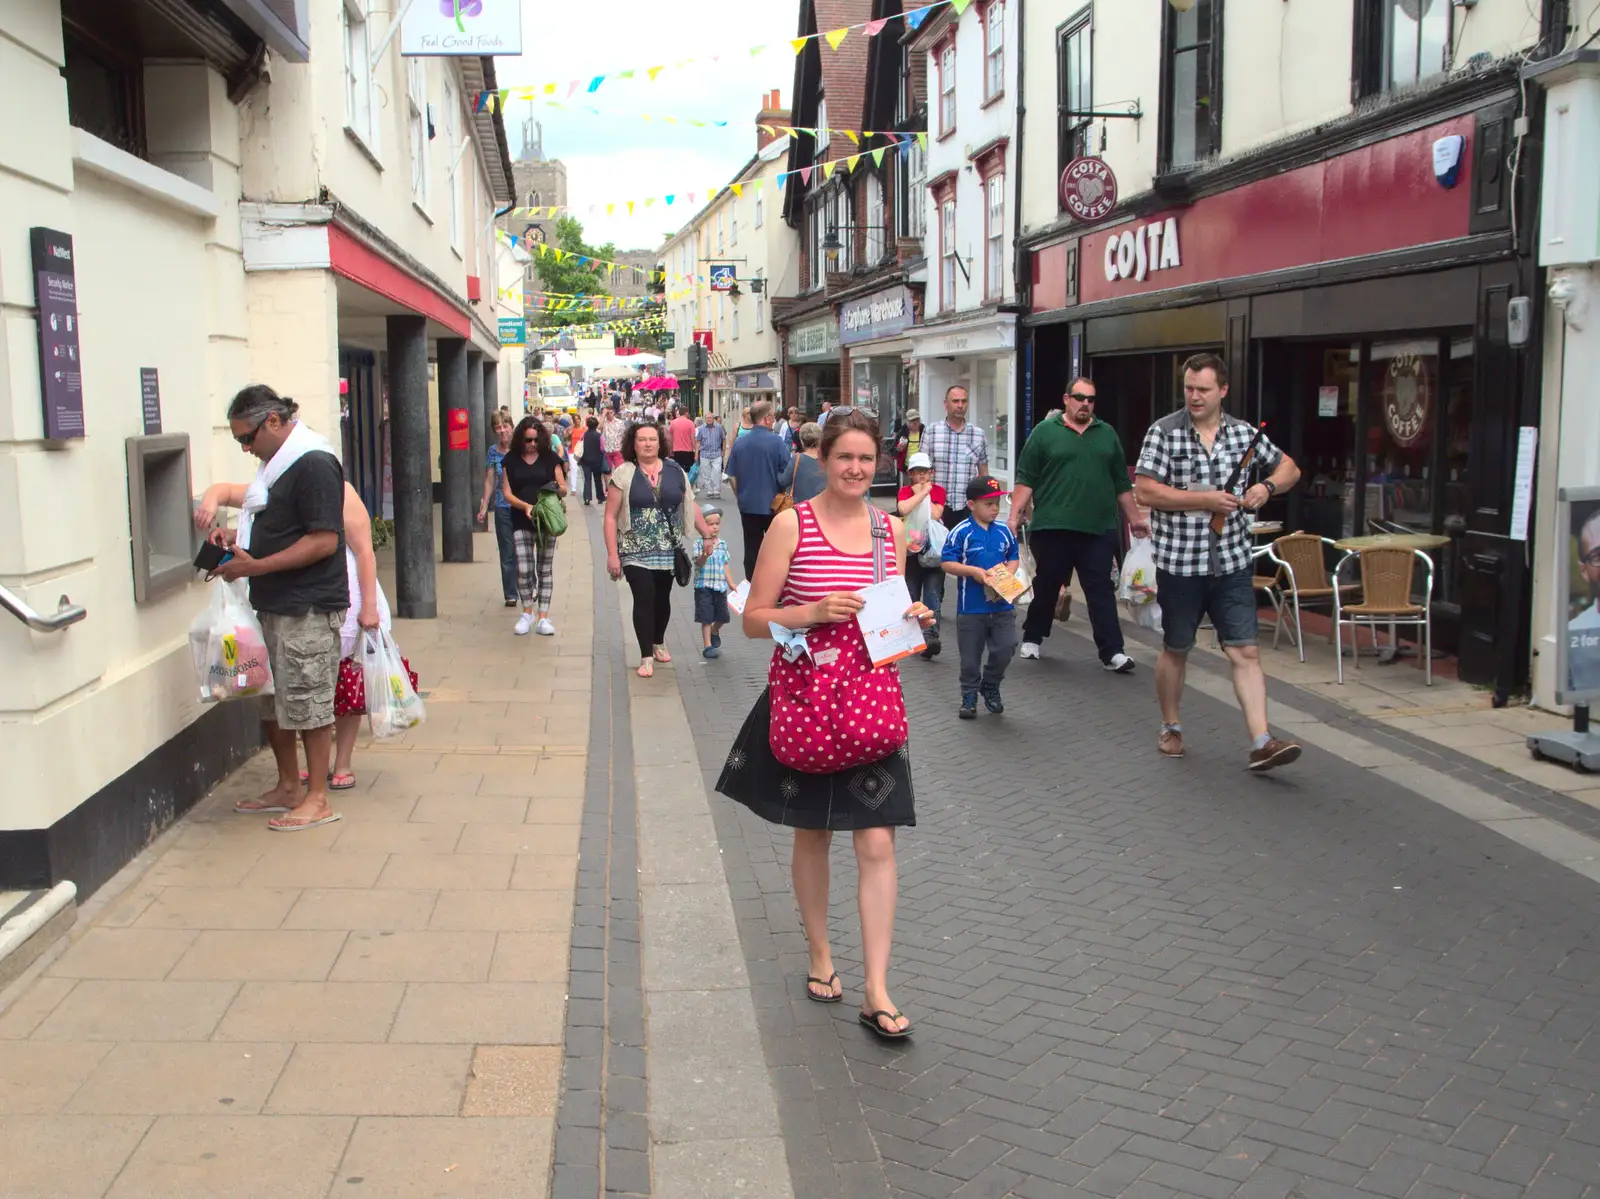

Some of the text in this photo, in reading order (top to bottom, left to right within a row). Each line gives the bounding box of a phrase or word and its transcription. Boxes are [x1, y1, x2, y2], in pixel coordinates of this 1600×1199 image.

[421, 34, 504, 50] Feel Good Foods
[1072, 162, 1107, 180] COSTA
[1068, 194, 1112, 217] COFFEE
[1104, 217, 1180, 282] COSTA
[847, 306, 870, 331] Carphone
[869, 298, 903, 322] Warehouse
[1388, 403, 1424, 436] COFFEE
[1570, 634, 1599, 648] 2 for
